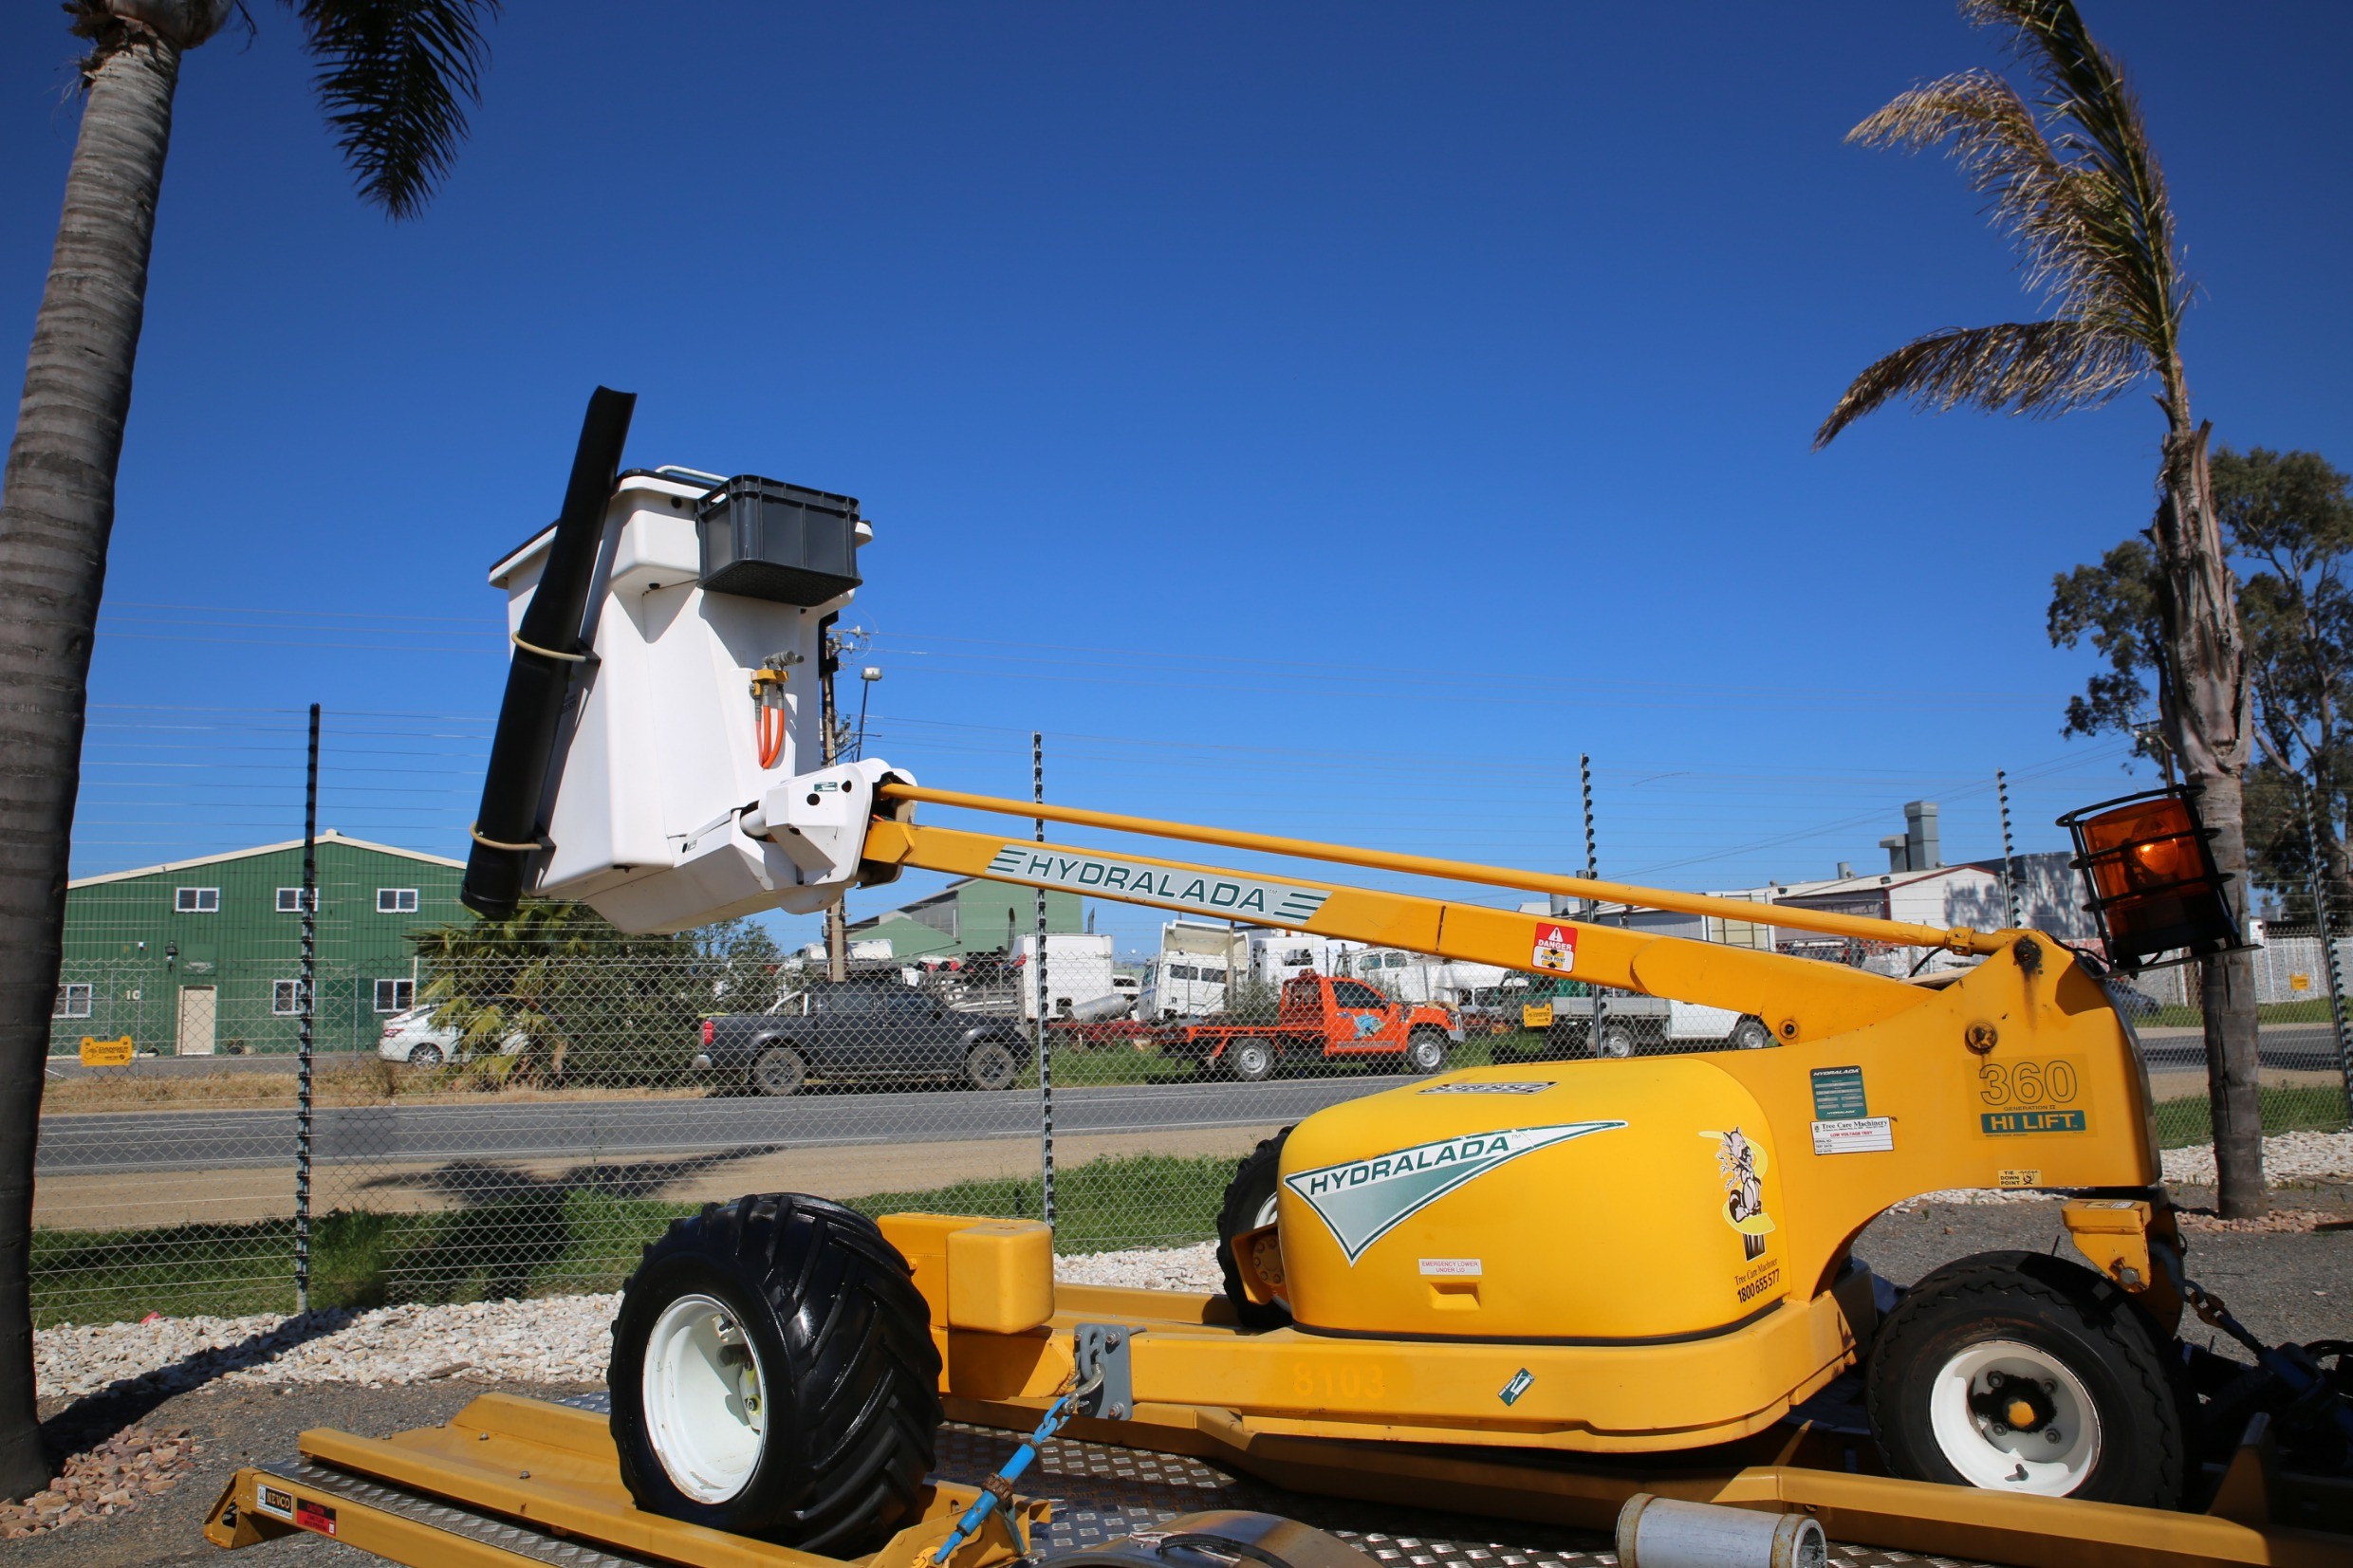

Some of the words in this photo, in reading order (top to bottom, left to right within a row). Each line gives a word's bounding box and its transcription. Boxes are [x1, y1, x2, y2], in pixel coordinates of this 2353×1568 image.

[1028, 854, 1265, 913] HYDRALADA
[1538, 939, 1572, 950] DANGER
[1979, 1060, 2078, 1106] 360
[1991, 1115, 2015, 1130] HI
[2023, 1114, 2075, 1129] LIFT
[1310, 1136, 1510, 1195] HYDRALADA
[1734, 1275, 1747, 1285] Tree
[1747, 1270, 1757, 1280] Care
[1737, 1282, 1755, 1303] 1800
[1755, 1276, 1769, 1294] 655
[1768, 1268, 1780, 1287] 577
[1293, 1361, 1387, 1398] 8103
